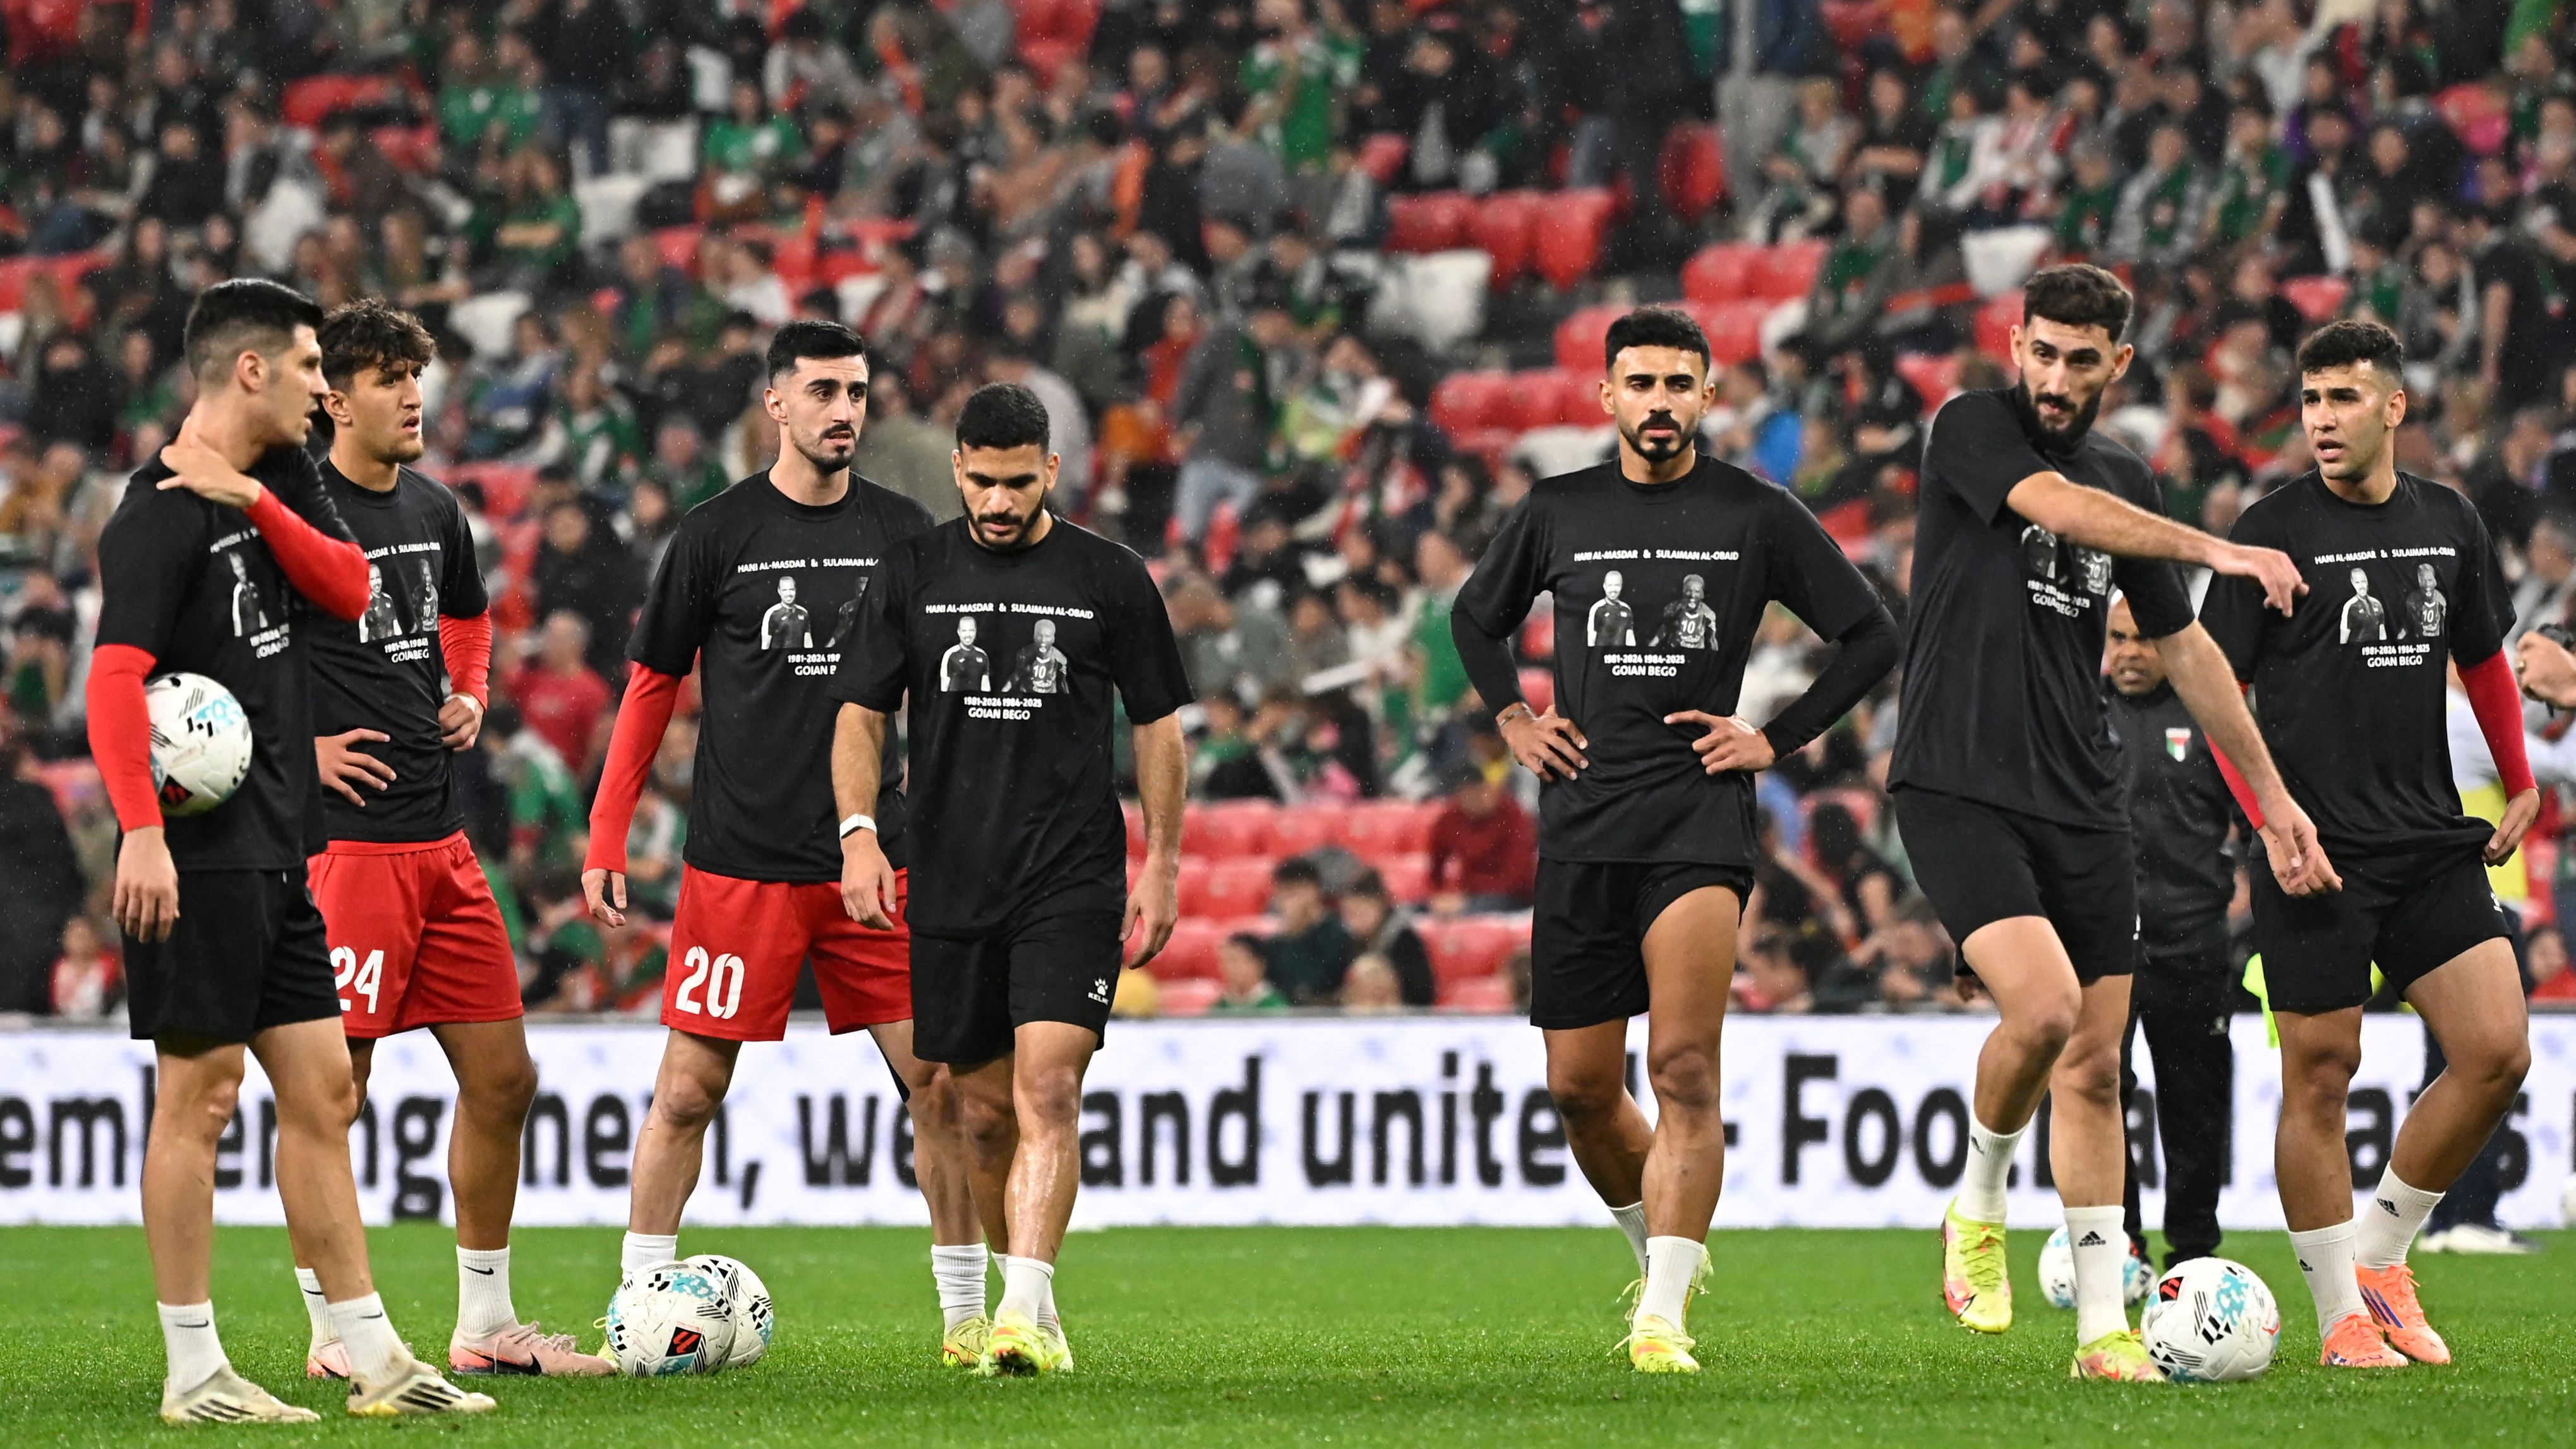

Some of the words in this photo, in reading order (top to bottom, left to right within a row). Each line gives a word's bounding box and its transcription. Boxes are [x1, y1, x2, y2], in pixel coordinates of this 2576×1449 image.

[1574, 552, 1592, 562] HANI
[1592, 550, 1638, 560] AL-MASDAR
[1643, 550, 1651, 559] &
[1656, 549, 1699, 560] SULAIMAN
[1700, 550, 1739, 561] AL-OBAID
[2314, 555, 2335, 565] HANI
[2336, 550, 2376, 562] AL-MASDAR
[2380, 549, 2388, 558] &
[2392, 547, 2429, 557] SULAIMAN
[738, 563, 758, 573] HANI
[759, 559, 805, 571] AL-MASDAR
[810, 558, 818, 568] &
[823, 558, 864, 567] SULAIMAN
[925, 604, 946, 614] HANI
[946, 603, 994, 613] AL-MASDAR
[999, 603, 1006, 613] &
[1011, 603, 1054, 615] SULAIMAN
[1055, 606, 1094, 620] AL-OBAID
[2423, 610, 2434, 623] 10
[1682, 620, 1695, 634] 10
[2362, 646, 2397, 656] 1981-2024
[788, 654, 826, 663] 1981-2024
[1604, 654, 1642, 664] 1981-2024
[1644, 654, 1685, 664] 1984-2025
[2367, 656, 2397, 668] GOIAN
[2399, 655, 2423, 666] BEGO
[795, 665, 828, 676] GOIAN
[1033, 664, 1046, 679] 10
[1612, 665, 1646, 676] GOIAN
[1647, 666, 1677, 677] BEGO
[963, 696, 1001, 707] 1981-2024
[1002, 697, 1042, 708] 1984-2025
[968, 707, 1001, 719] GOIAN
[1002, 708, 1031, 721] BEGO
[331, 946, 384, 1014] 24
[675, 946, 745, 1019] 20
[1299, 1051, 1636, 1187] unite
